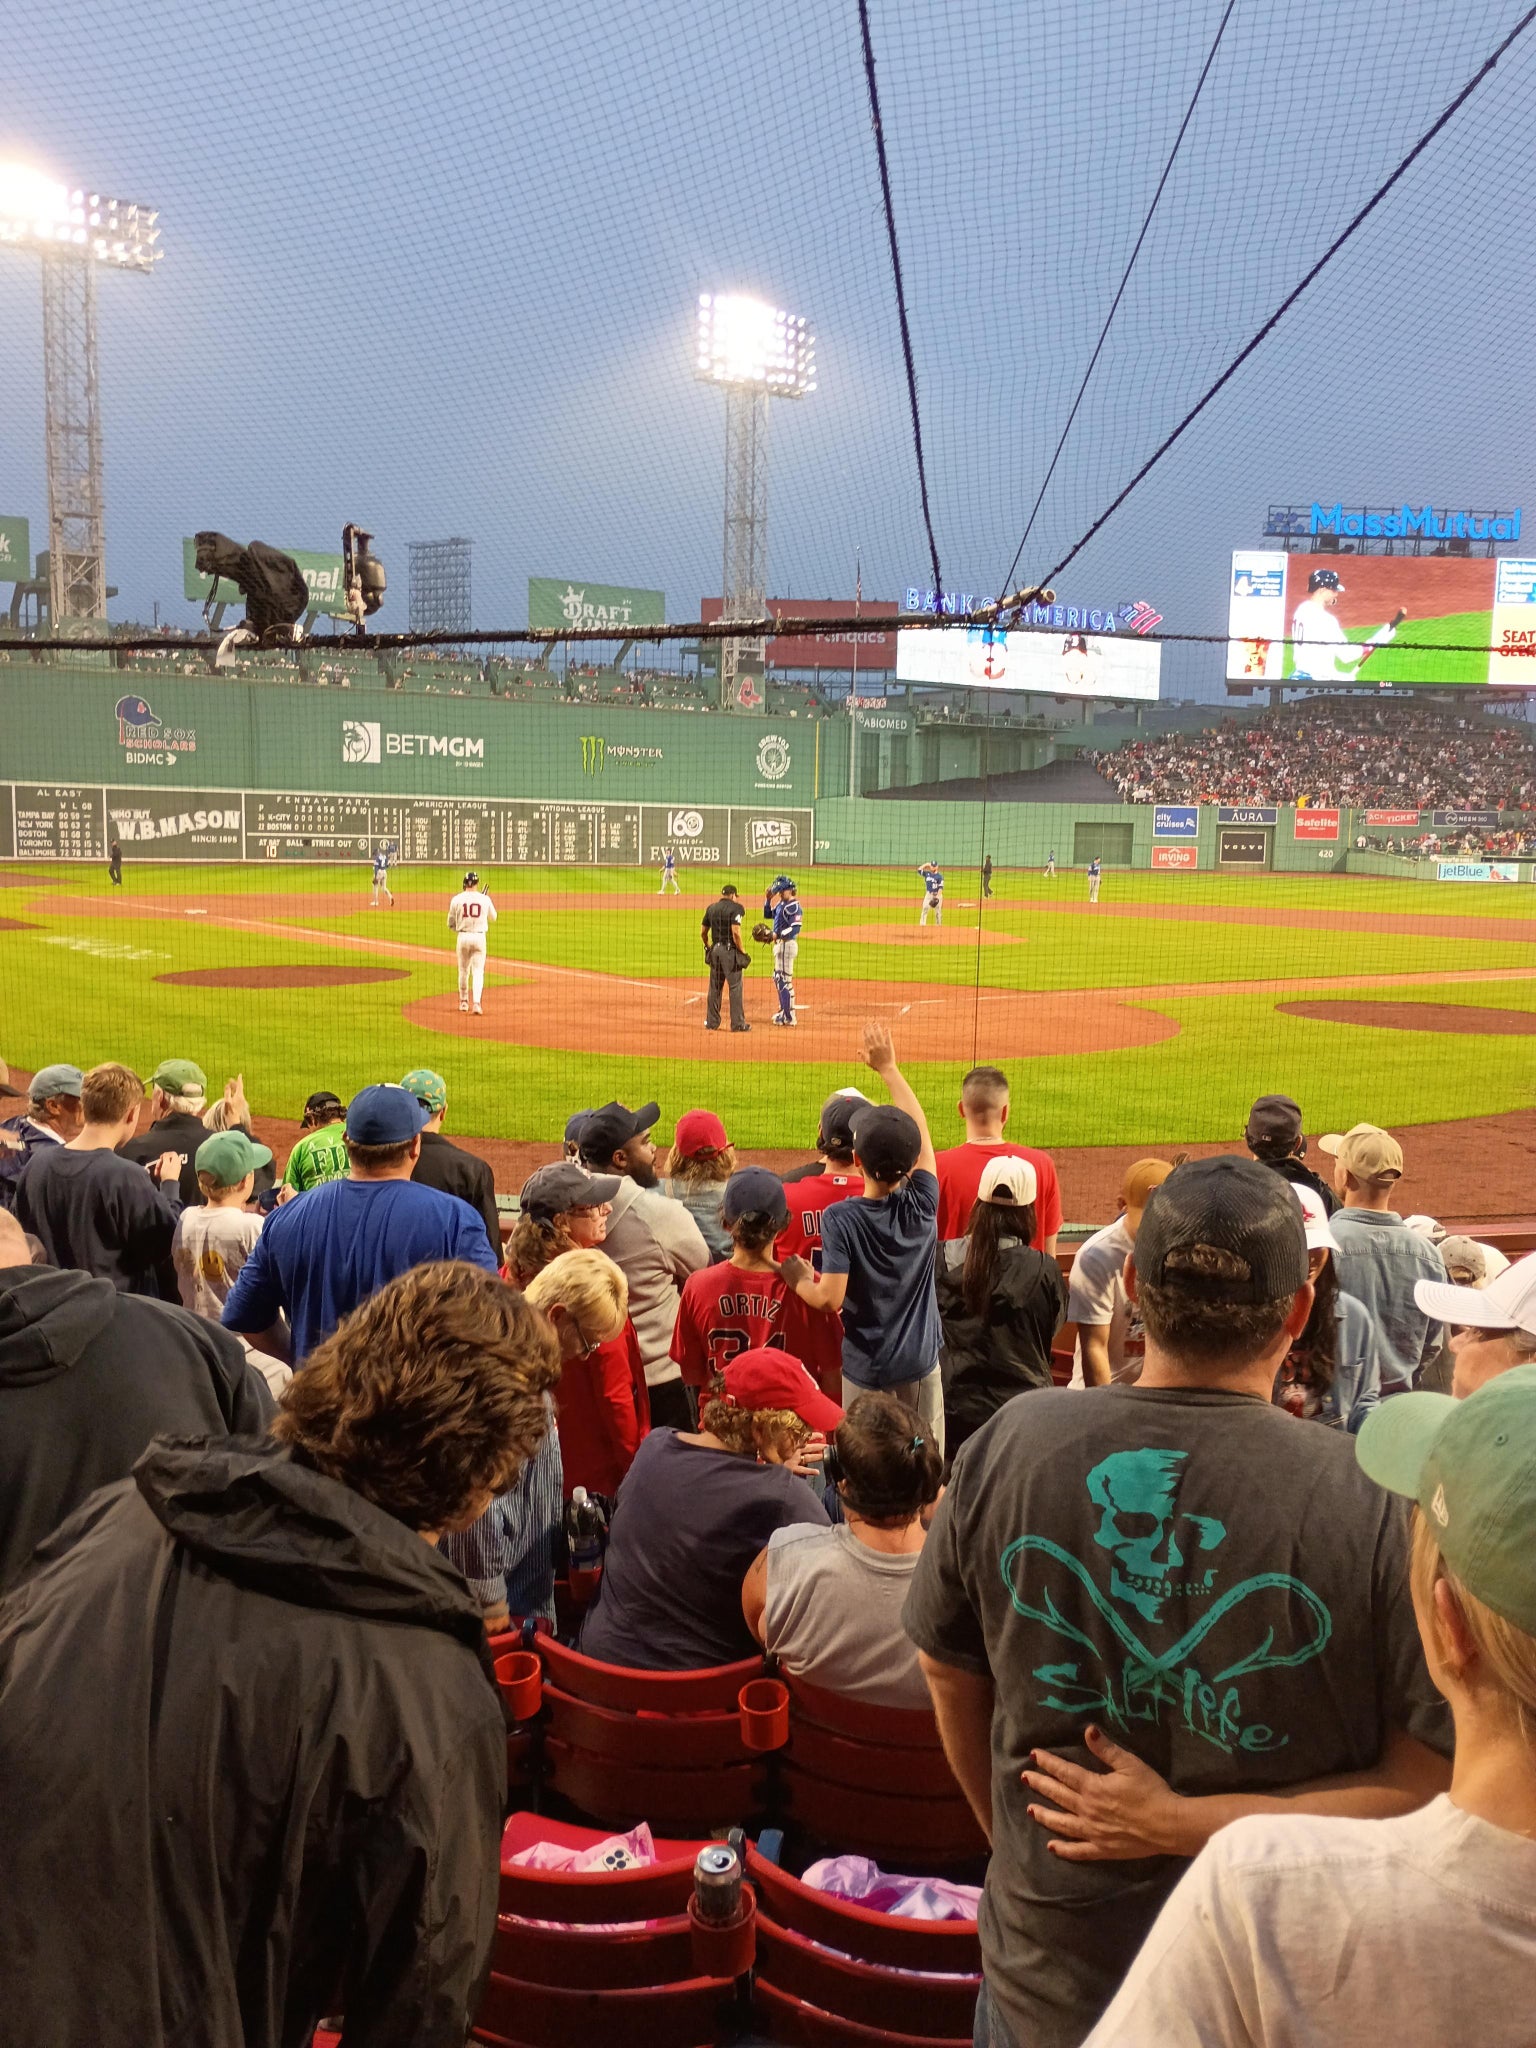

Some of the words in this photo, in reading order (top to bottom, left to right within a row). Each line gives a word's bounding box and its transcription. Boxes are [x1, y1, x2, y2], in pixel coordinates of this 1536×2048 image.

[1310, 502, 1522, 541] MassMutual
[906, 588, 975, 615] BANK
[563, 601, 632, 622] DRAFT
[1502, 630, 1536, 644] SEAT
[864, 717, 908, 730] ABIOMED
[126, 725, 158, 739] RED
[163, 728, 196, 741] SOX
[126, 738, 197, 752] SCHOLARS
[386, 733, 484, 758] BETMGM
[607, 745, 663, 759] MONSTER
[126, 752, 163, 765] BIDMC
[37, 789, 50, 797] AL
[55, 790, 82, 798] EAST
[276, 796, 328, 804] FENWAY
[413, 800, 454, 809] AMERICAN
[109, 809, 132, 820] WHO
[133, 808, 151, 820] BUT
[330, 806, 335, 814] 6
[360, 807, 367, 815] 10
[508, 811, 512, 819] P
[540, 805, 575, 813] NATIONAL
[578, 806, 605, 814] LEAGUE
[18, 811, 40, 819] TAMPA
[41, 812, 55, 820] BAY
[1156, 813, 1172, 824] city
[1386, 813, 1418, 823] TICKET
[36, 821, 53, 829] YORK
[71, 822, 80, 830] 63
[267, 823, 292, 832] BOSTON
[667, 810, 704, 837] 160
[1156, 819, 1185, 829] cruises
[1296, 818, 1338, 827] Safelite
[18, 830, 47, 838] BOSTON
[755, 820, 792, 837] ACE
[20, 839, 52, 847] TORONTO
[71, 840, 81, 848] 75
[191, 835, 217, 843] SINCE
[286, 839, 303, 847] BALL
[338, 840, 352, 848] OUT
[756, 835, 792, 848] TICKET
[19, 849, 56, 857] BALTIMORE
[60, 849, 69, 857] 72
[72, 849, 81, 857] 78
[266, 846, 277, 858] 10
[678, 847, 720, 862] WEBB
[1158, 853, 1190, 862] IRVING
[1318, 850, 1334, 858] 420
[1442, 865, 1483, 877] jetBlue
[463, 903, 481, 918] 10
[719, 1293, 782, 1323] ORTIZ
